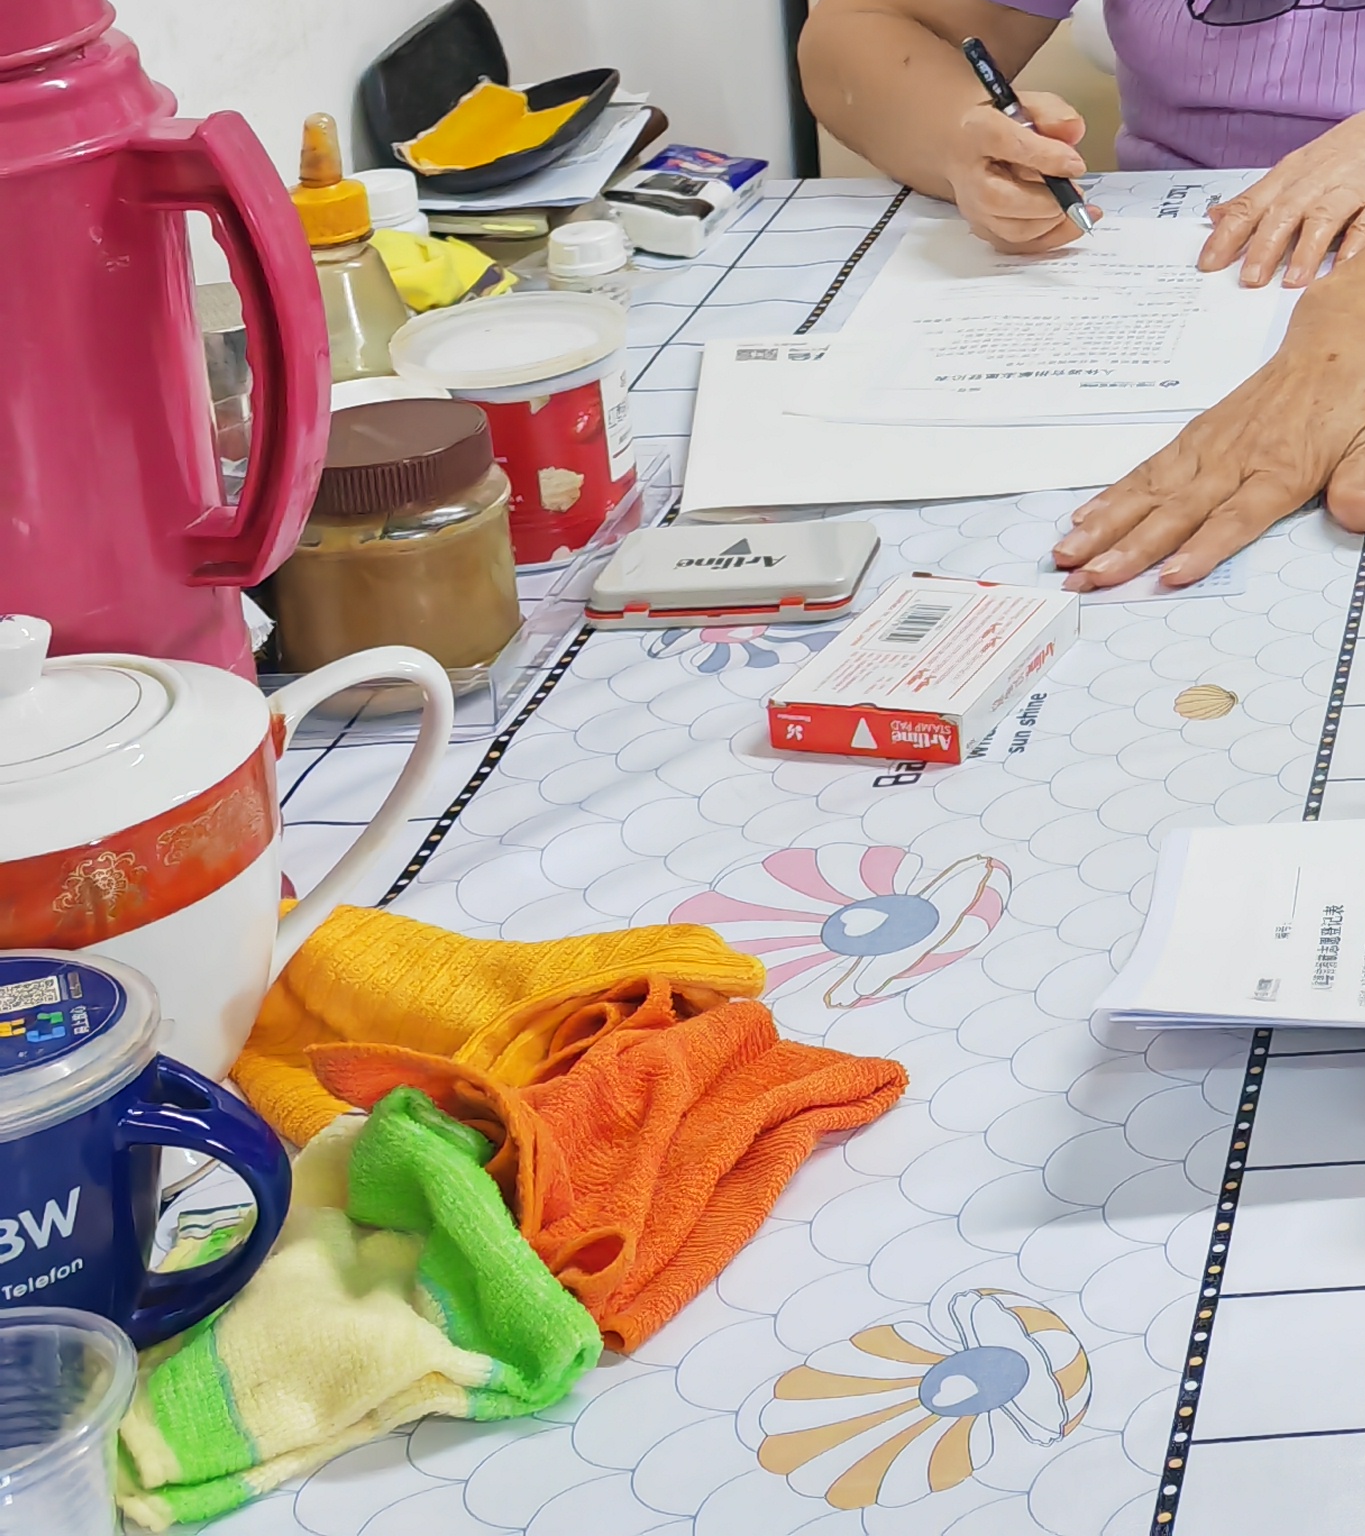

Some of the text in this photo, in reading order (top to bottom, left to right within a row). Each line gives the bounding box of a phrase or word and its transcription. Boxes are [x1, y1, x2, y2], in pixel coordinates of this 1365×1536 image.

[675, 555, 787, 570] Artline
[1008, 692, 1047, 753] sun shine
[891, 730, 951, 751] Artline
[1, 1257, 83, 1300] Telefon
